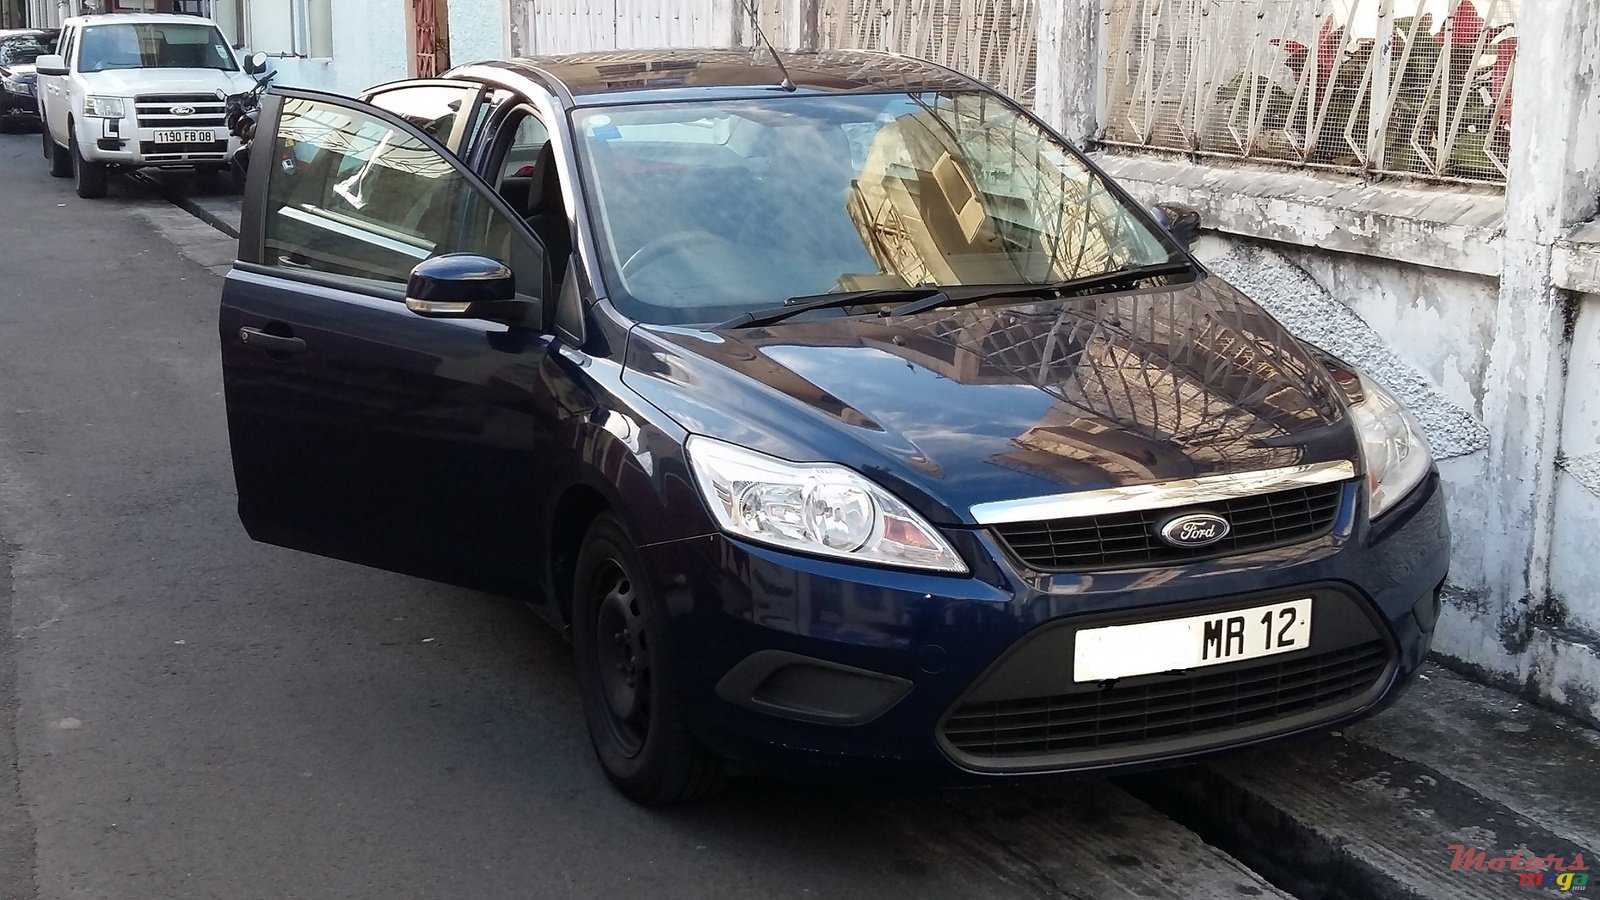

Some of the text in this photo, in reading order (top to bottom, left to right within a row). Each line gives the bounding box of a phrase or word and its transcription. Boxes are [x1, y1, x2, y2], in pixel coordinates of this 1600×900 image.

[159, 132, 211, 142] 1190 FB 08
[1180, 521, 1216, 541] Ford
[1202, 607, 1297, 660] MR 12
